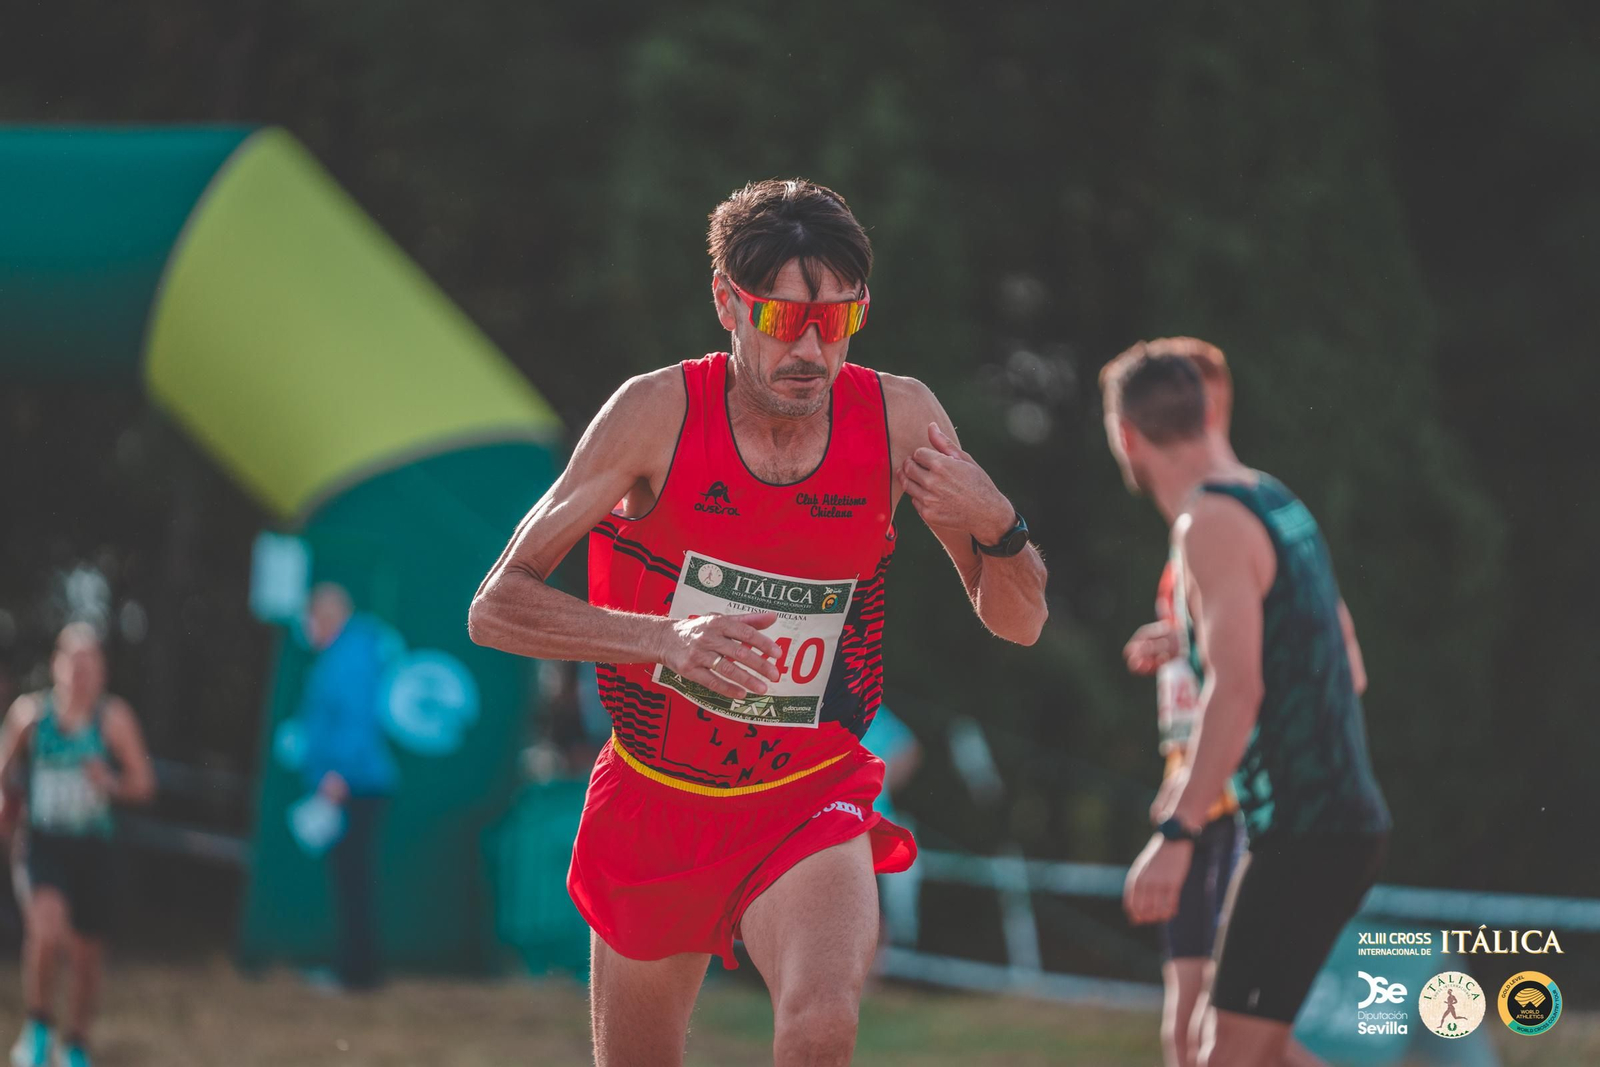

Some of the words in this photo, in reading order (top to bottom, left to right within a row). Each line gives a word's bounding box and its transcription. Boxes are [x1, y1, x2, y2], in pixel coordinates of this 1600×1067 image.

[796, 493, 819, 505] Club
[822, 493, 867, 505] Atletismo
[810, 506, 853, 518] Chiclana
[733, 575, 814, 605] ITÁLICA
[777, 612, 807, 621] HICLANA
